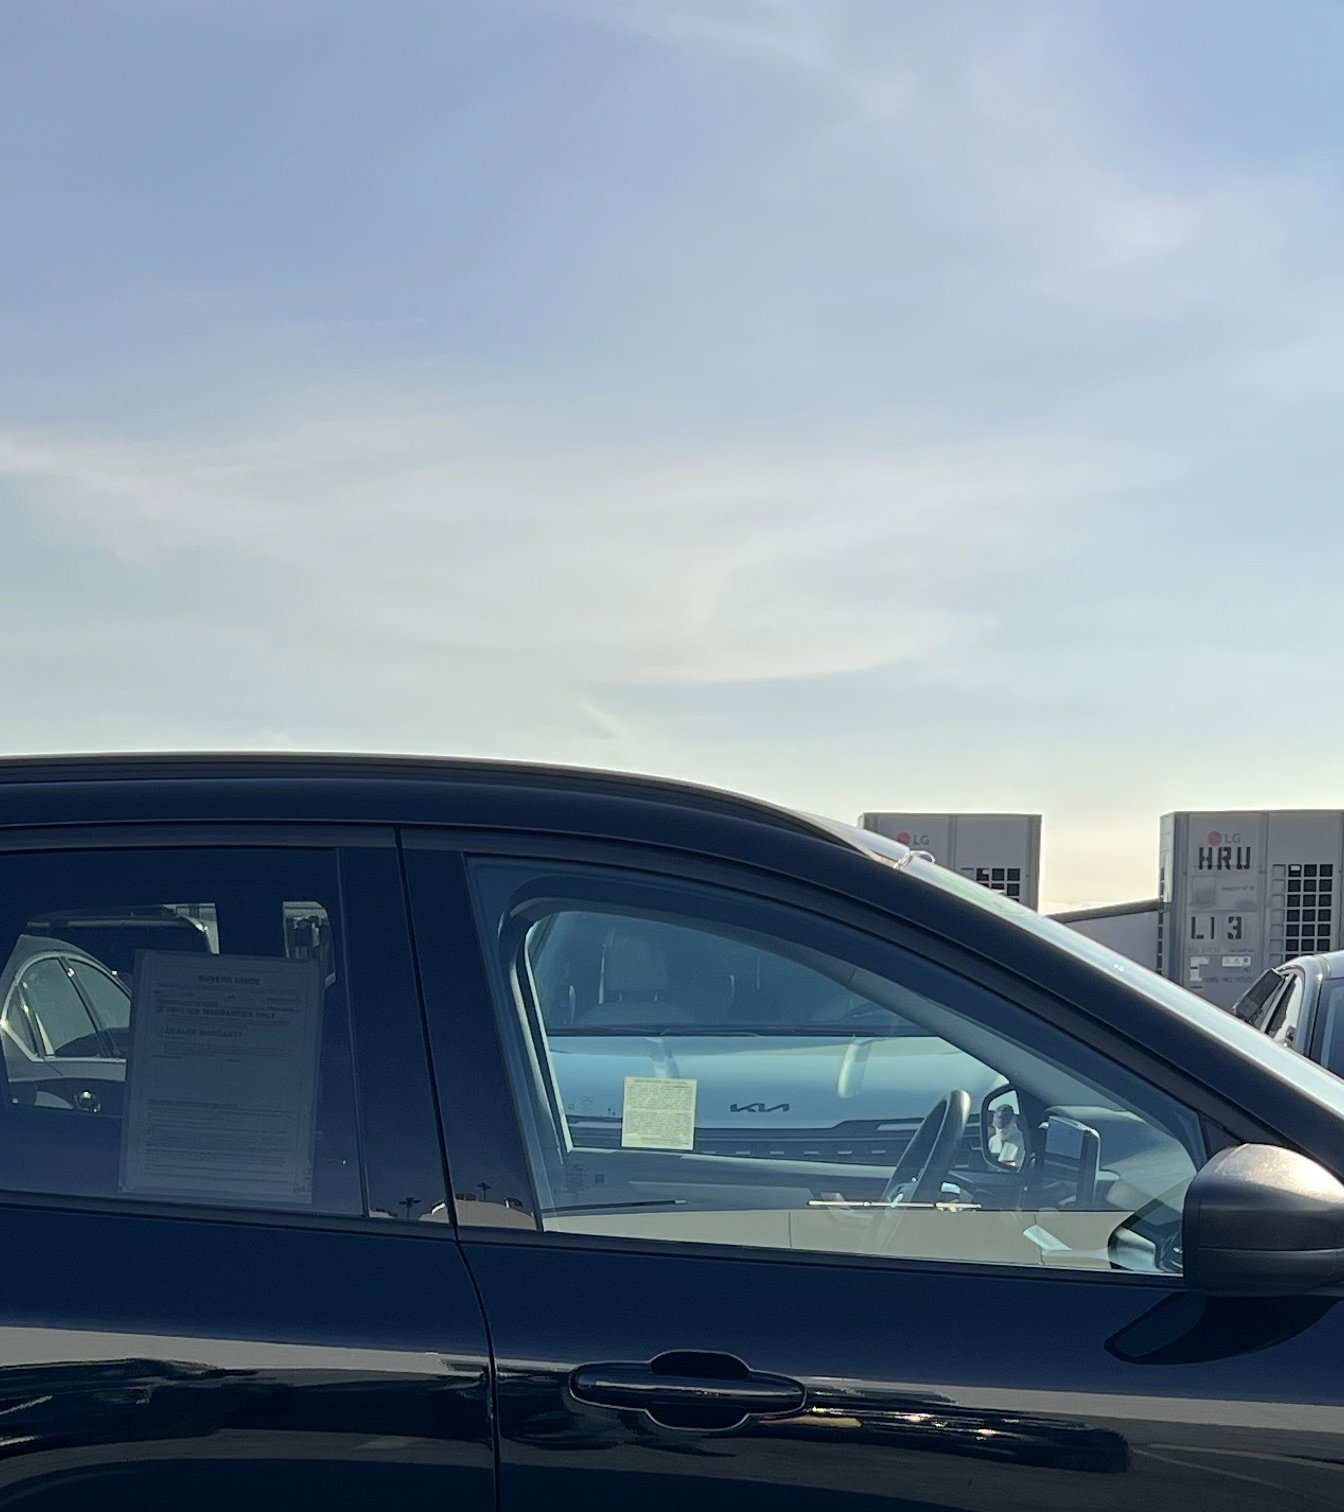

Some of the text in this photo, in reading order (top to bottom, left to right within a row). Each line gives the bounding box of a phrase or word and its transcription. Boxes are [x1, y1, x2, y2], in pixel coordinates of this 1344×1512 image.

[913, 834, 930, 846] LG
[1224, 833, 1241, 844] LG
[1198, 846, 1251, 870] HRU
[730, 1102, 790, 1113] KIA
